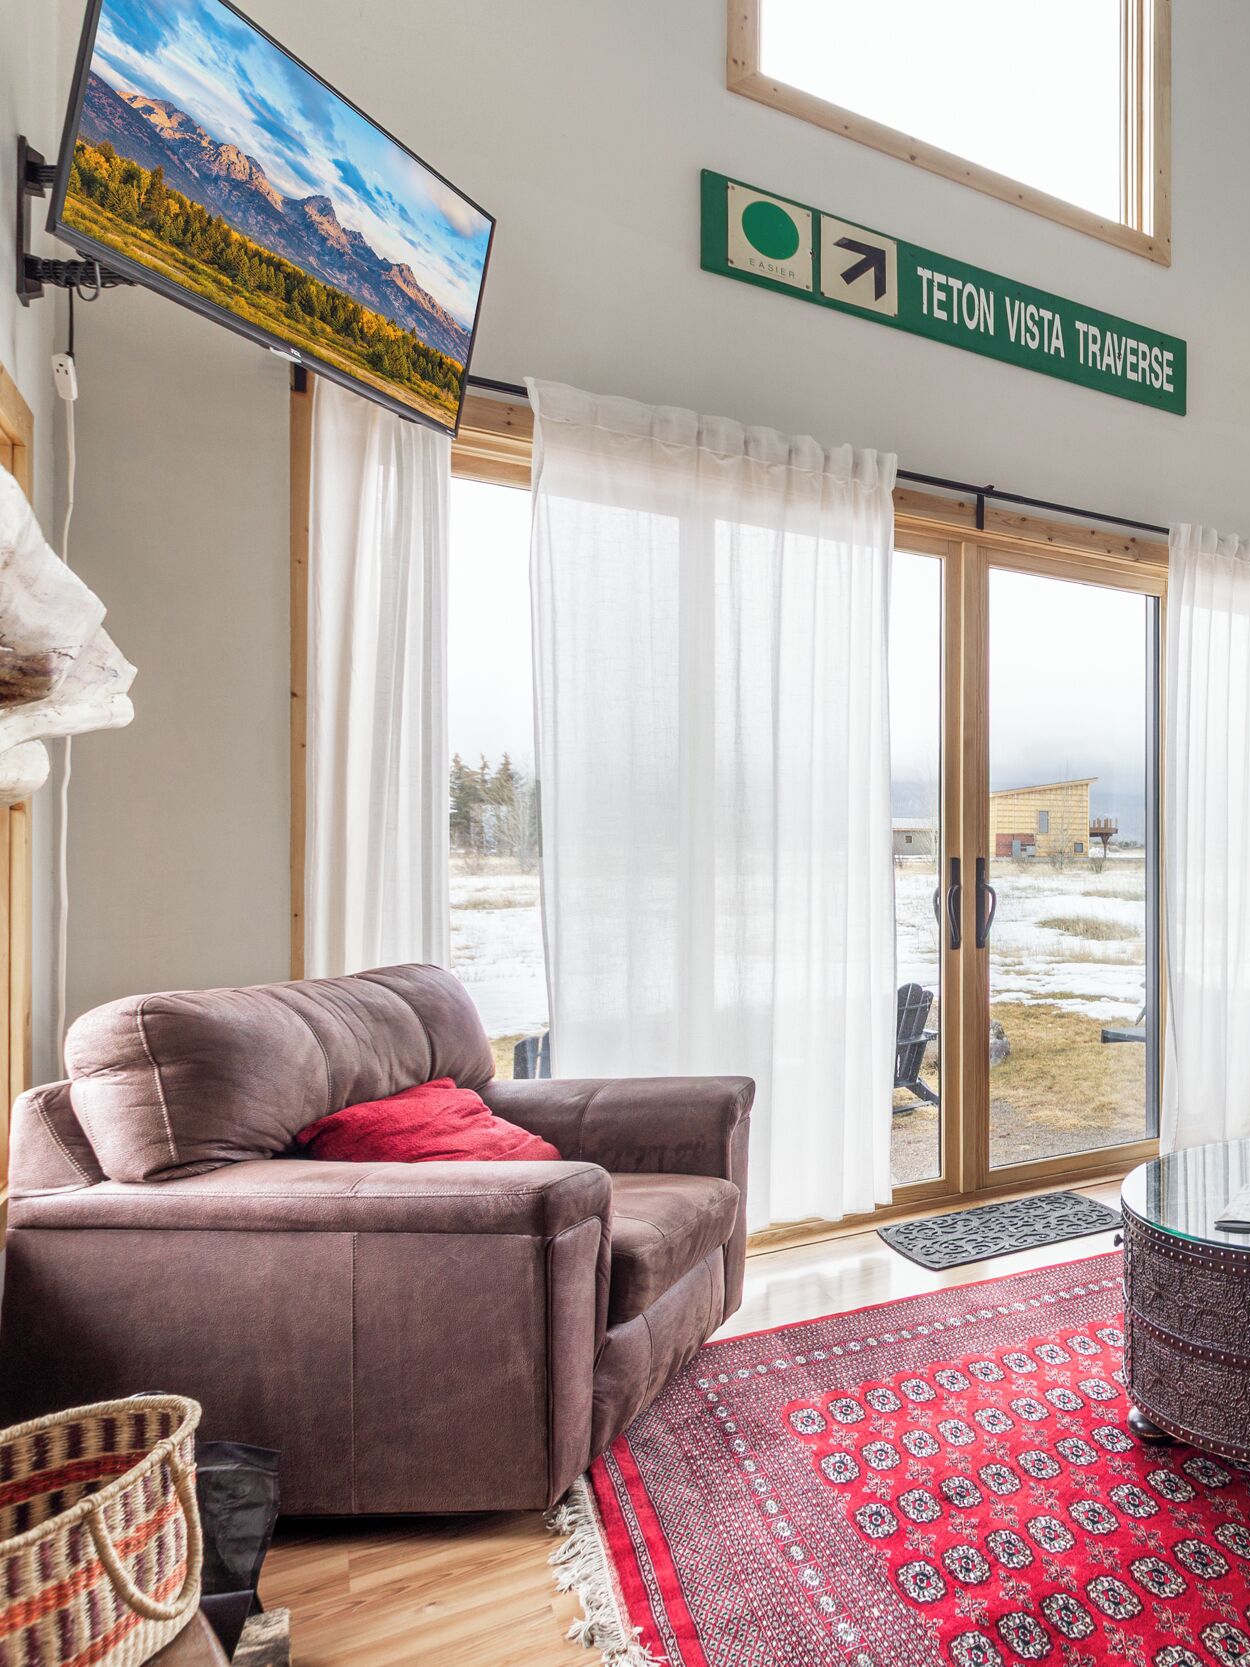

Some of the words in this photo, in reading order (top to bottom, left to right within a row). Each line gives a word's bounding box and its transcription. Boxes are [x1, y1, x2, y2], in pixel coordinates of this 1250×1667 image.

[749, 258, 795, 279] EASIER
[917, 266, 995, 335] TETON
[1005, 296, 1065, 358] VISTA
[1075, 320, 1175, 393] TRAVERSE
